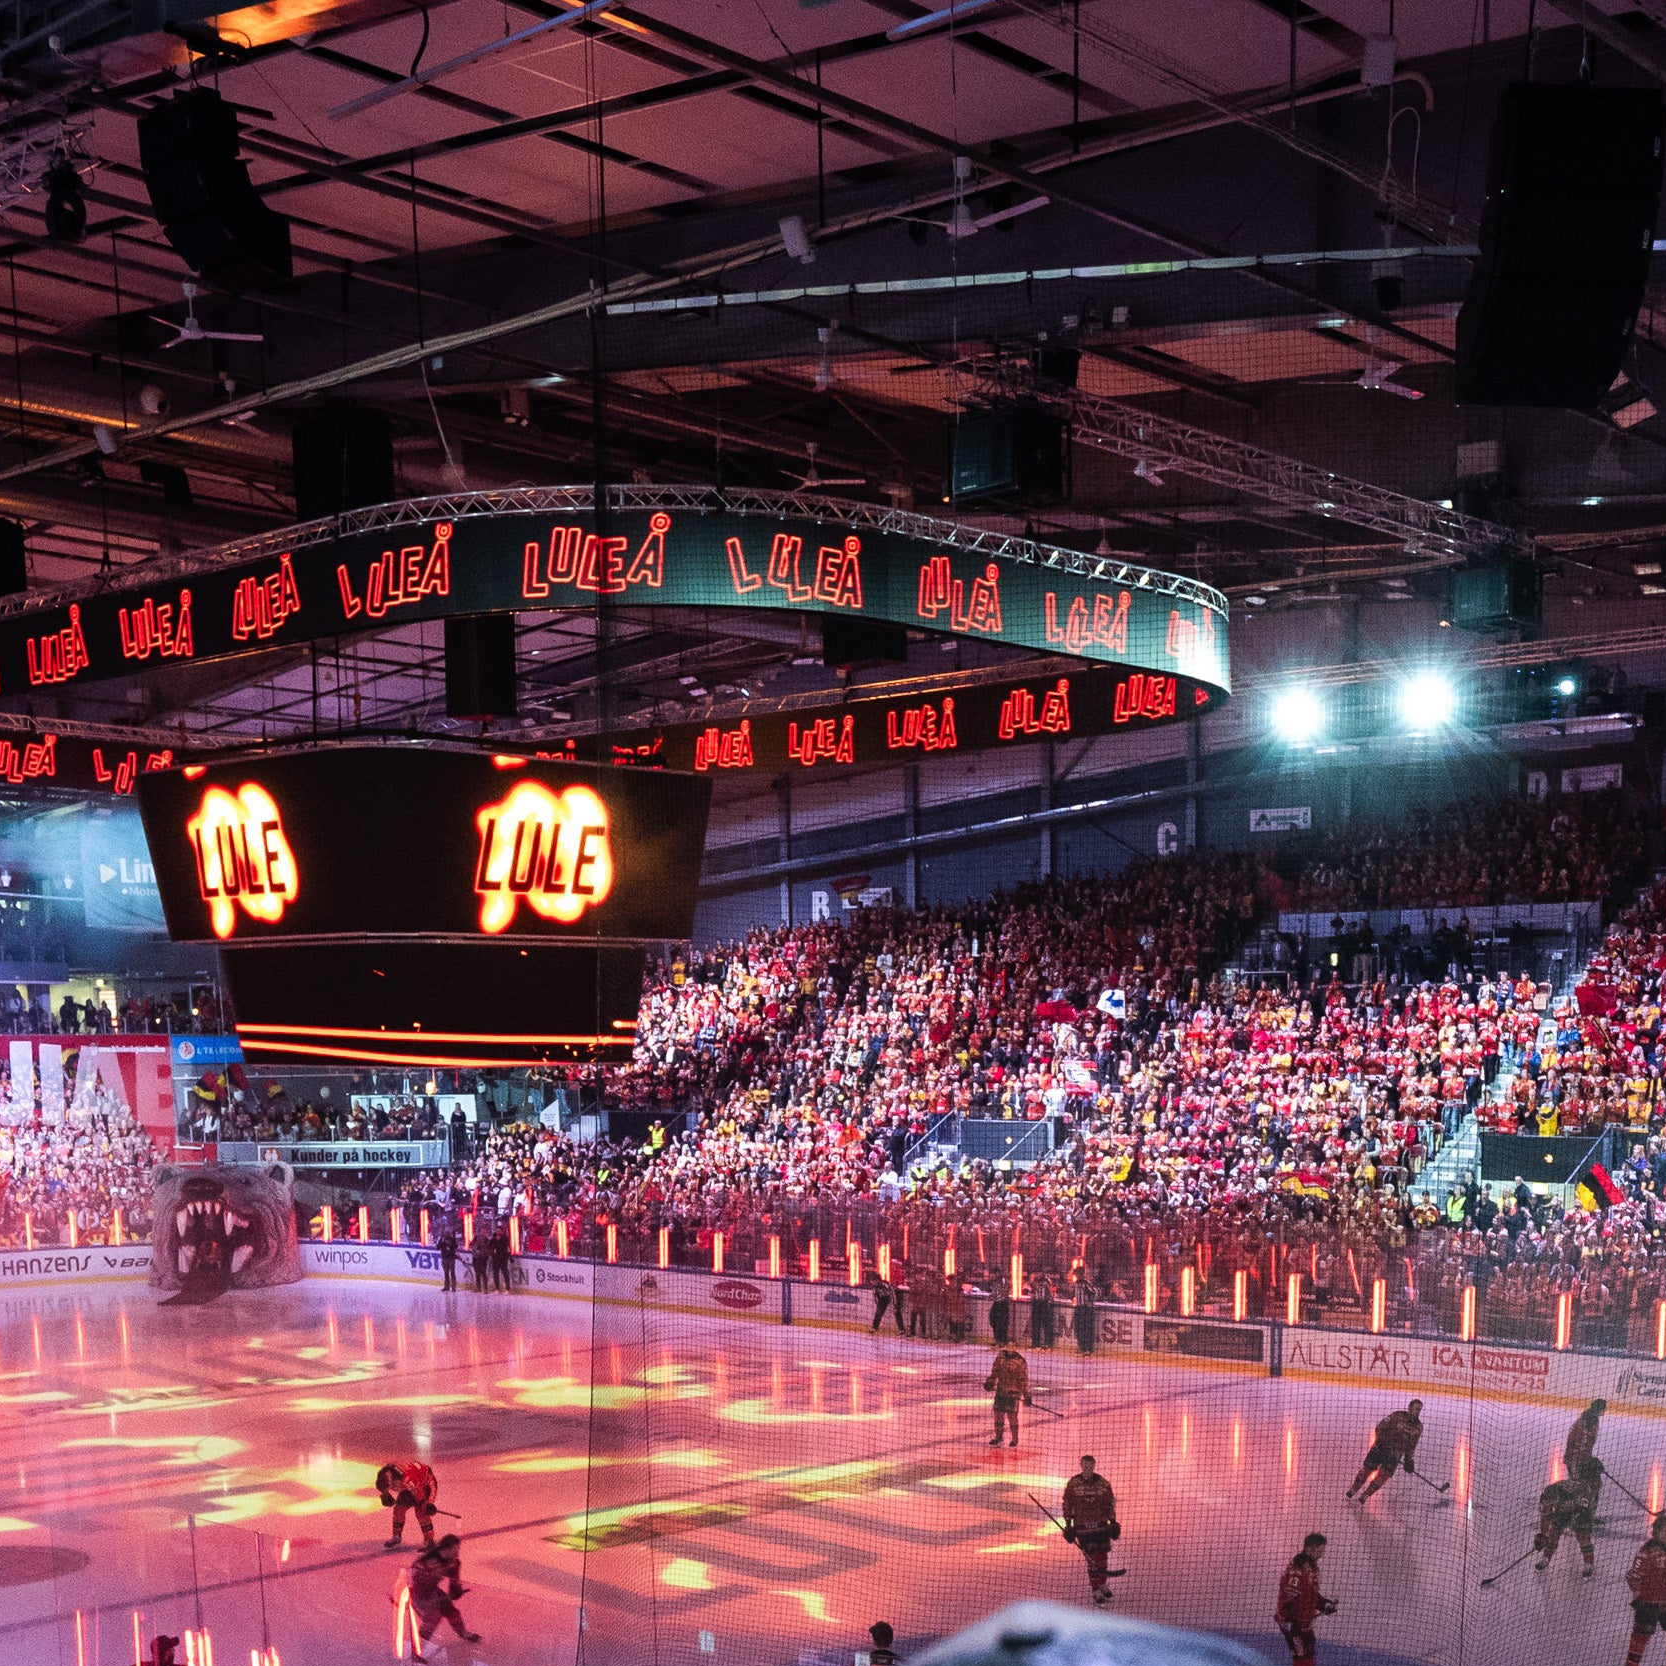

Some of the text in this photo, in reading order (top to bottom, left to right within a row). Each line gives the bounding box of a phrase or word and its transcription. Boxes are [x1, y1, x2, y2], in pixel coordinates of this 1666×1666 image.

[337, 522, 452, 618] LULEÅ
[522, 511, 672, 598] LULEÅ
[724, 534, 863, 609] LULEÅ
[233, 554, 300, 641] LULEÅ
[917, 556, 1002, 633] LULEÅ
[26, 603, 89, 685] LULEÅ
[118, 589, 193, 660] LULEÅ
[887, 697, 958, 751] LULEÅ
[999, 679, 1071, 739] LULEÅ
[694, 719, 754, 771] LULEÅ
[788, 714, 854, 766] LULEÅ
[476, 819, 606, 895] LULE
[1157, 822, 1178, 856] C
[291, 1148, 412, 1165] Kunder på hockey
[315, 1250, 368, 1271] winpos
[546, 1271, 585, 1285] Stockhult
[1290, 1340, 1410, 1376] ALLSTAR
[1432, 1345, 1465, 1367] ICA
